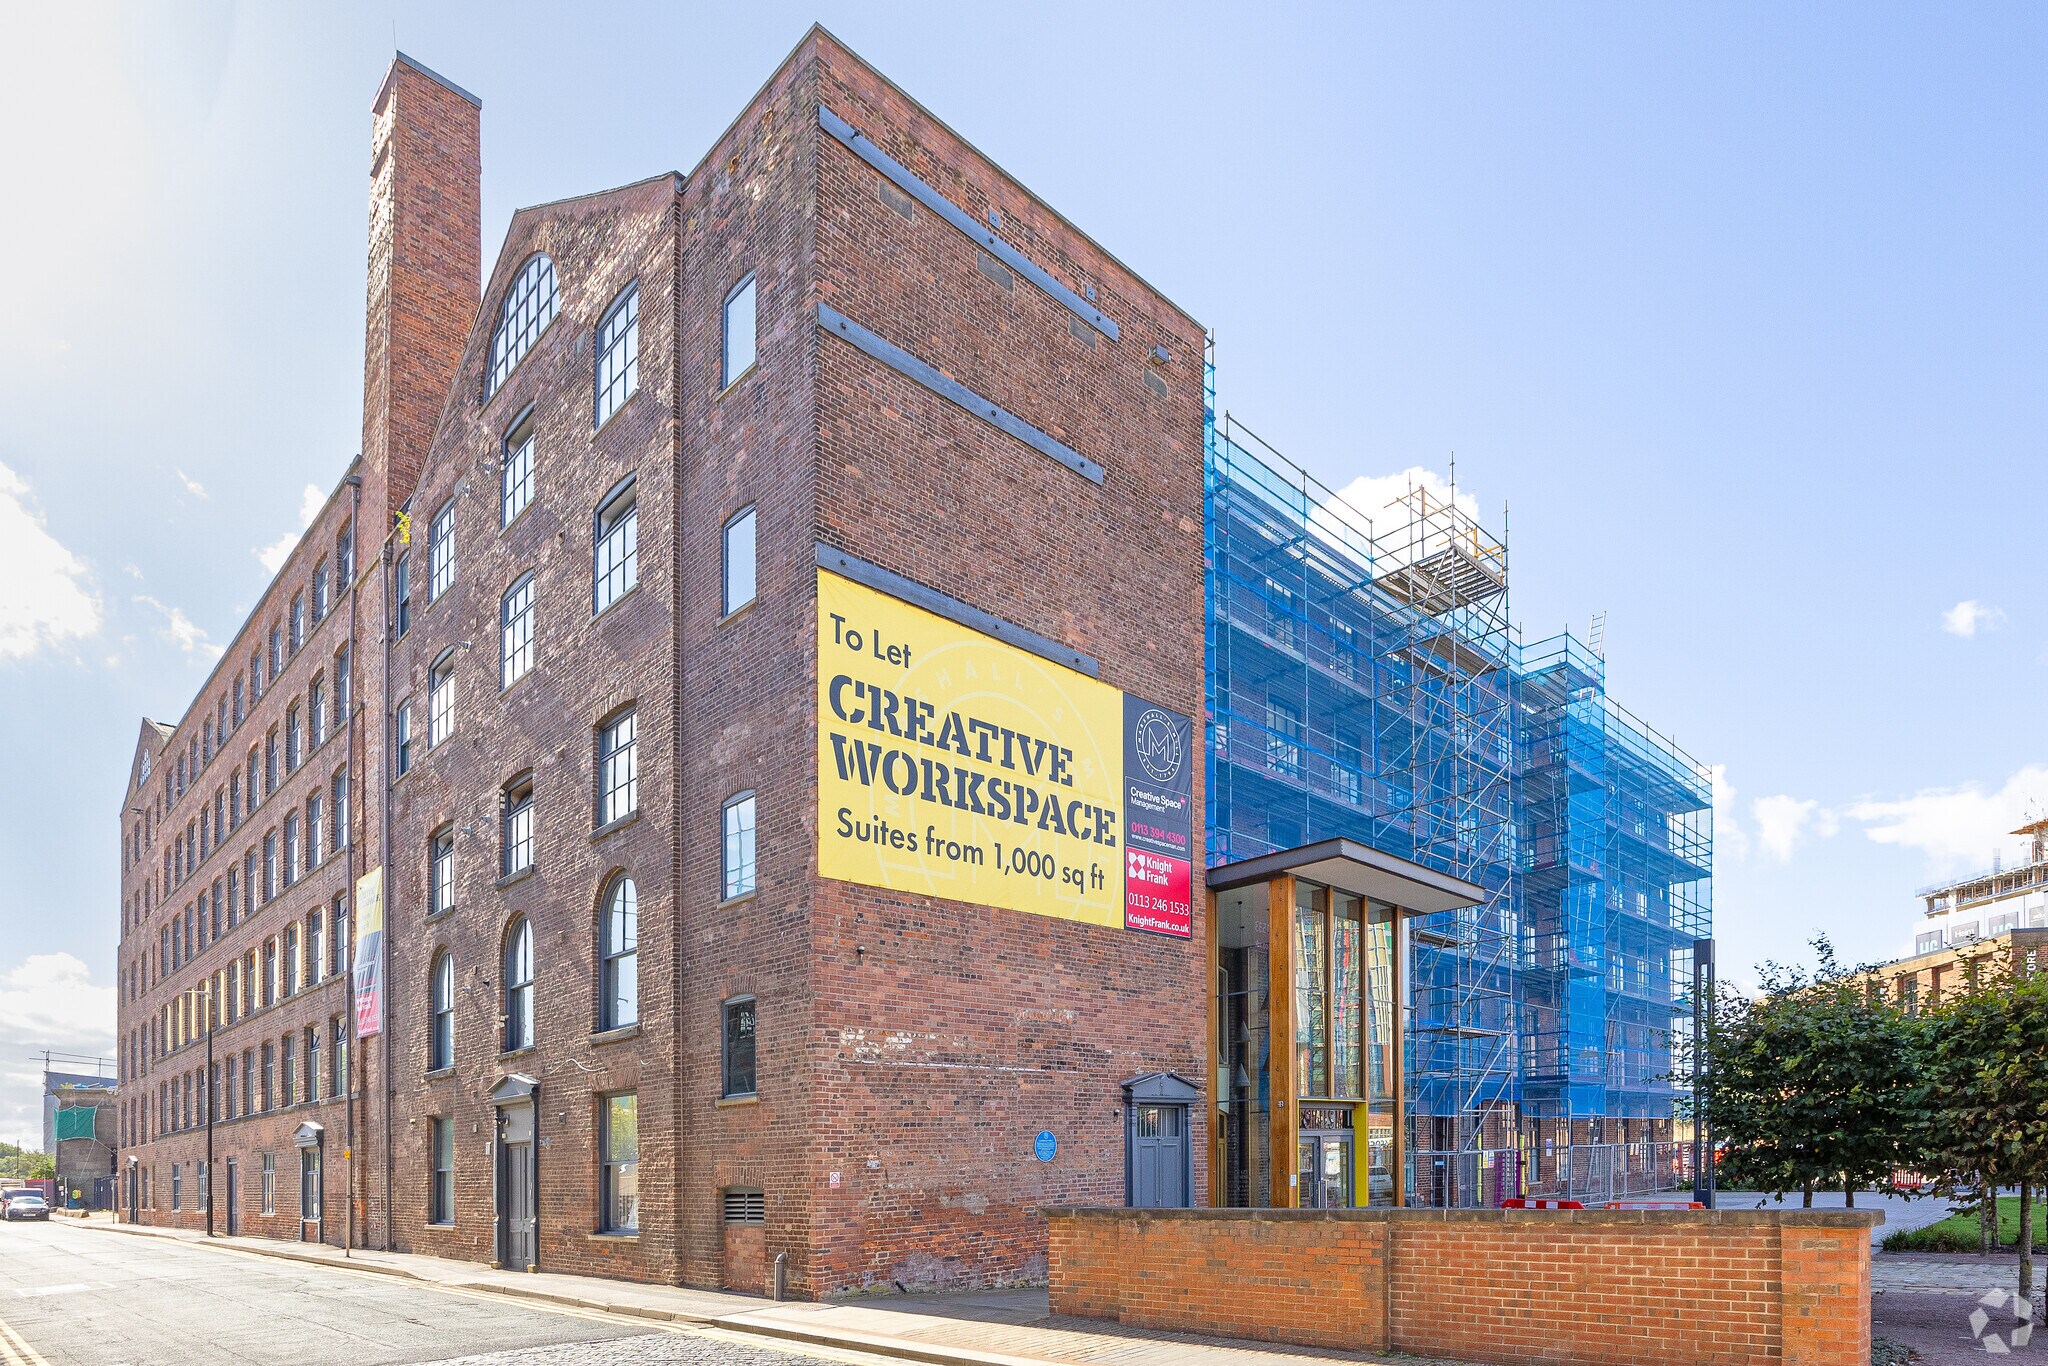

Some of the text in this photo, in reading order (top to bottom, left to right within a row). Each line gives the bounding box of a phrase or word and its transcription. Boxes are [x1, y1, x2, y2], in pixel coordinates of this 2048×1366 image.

[830, 612, 912, 669] To Let
[829, 674, 1073, 787] CREATIVE
[829, 732, 1116, 848] WORKSPACE
[1130, 787, 1160, 804] Creative
[1160, 795, 1182, 810] Space
[1130, 796, 1166, 813] Management
[1131, 821, 1187, 846] 0113 394 4300
[836, 807, 1105, 895] Suites from 1,000 sq ft
[1147, 856, 1173, 874] Knight
[1147, 870, 1169, 886] Frank
[1128, 892, 1189, 916] 0113 246 1533
[1128, 913, 1189, 933] KnightFrank.co.uk
